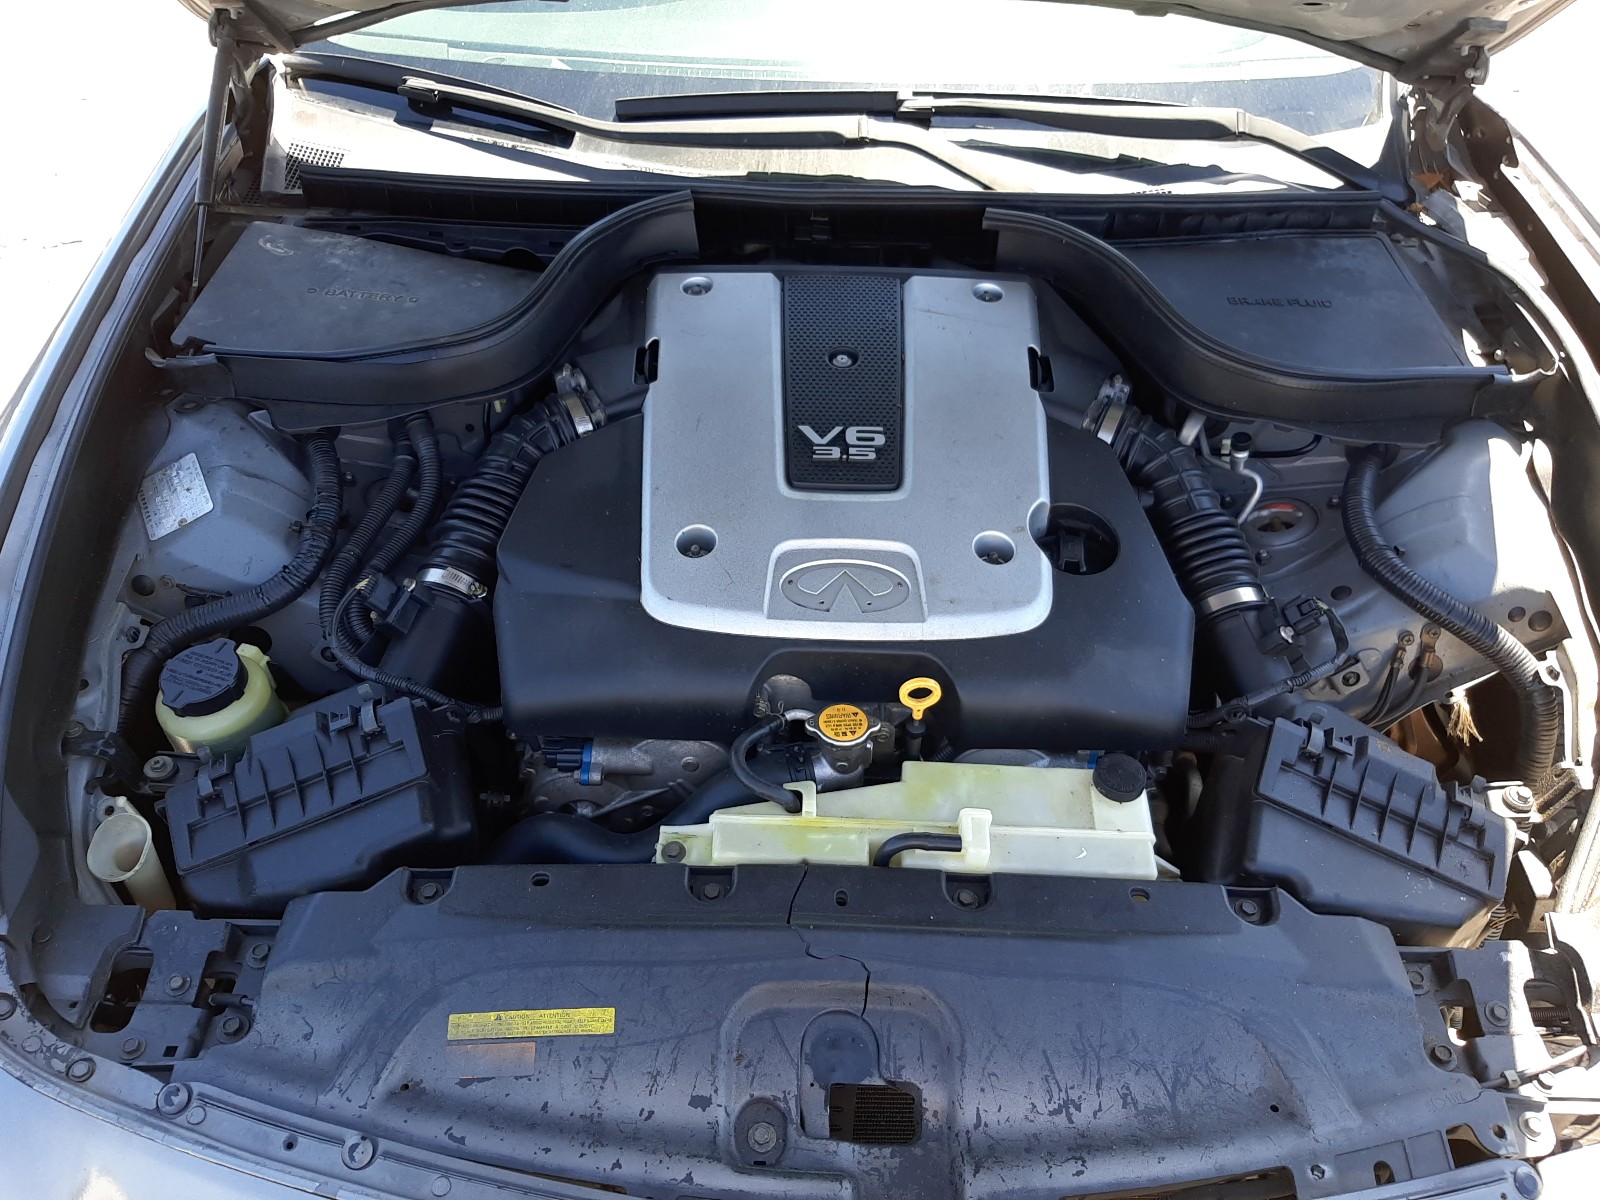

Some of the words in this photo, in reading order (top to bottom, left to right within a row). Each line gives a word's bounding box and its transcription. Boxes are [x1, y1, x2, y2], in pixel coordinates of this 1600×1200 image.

[323, 289, 403, 301] BATTERY
[1226, 296, 1284, 307] BRAKE
[1286, 298, 1333, 308] FLUID
[797, 425, 886, 446] V6
[812, 446, 877, 460] 3.5
